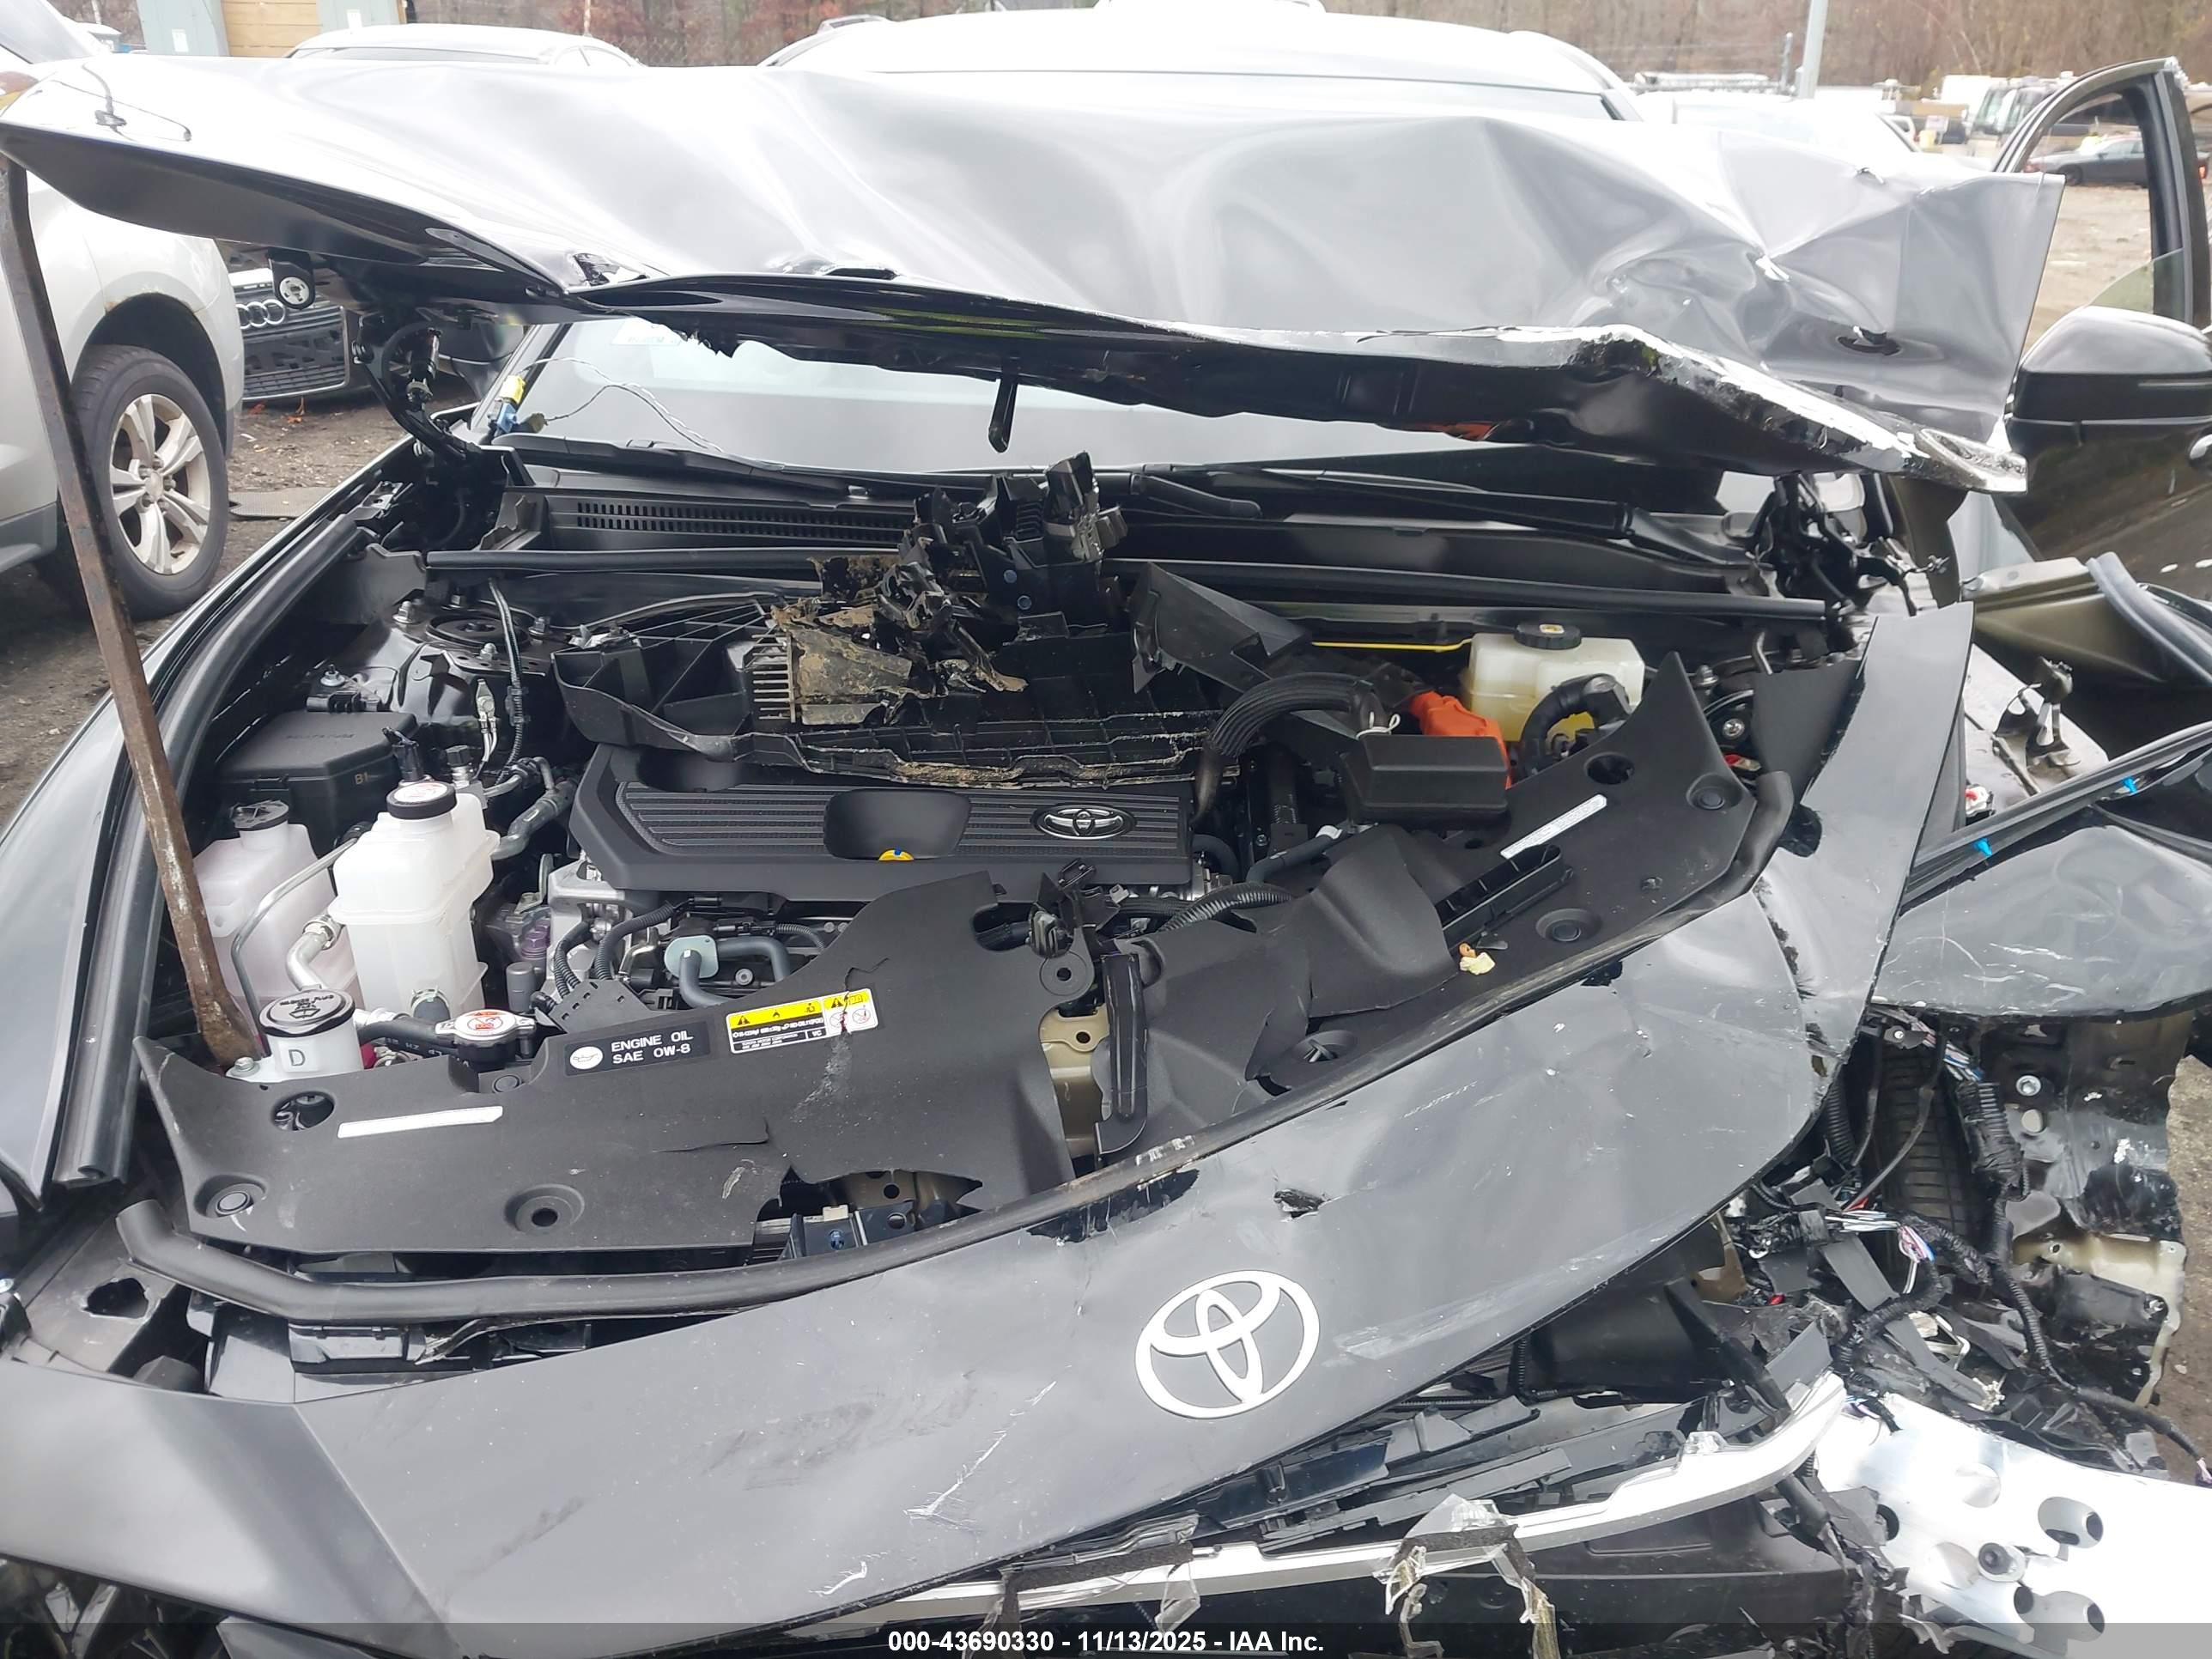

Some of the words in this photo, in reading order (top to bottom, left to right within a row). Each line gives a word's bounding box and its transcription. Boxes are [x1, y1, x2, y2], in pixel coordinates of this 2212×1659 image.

[611, 1035, 663, 1052] ENGINE
[671, 1030, 694, 1042] OIL
[289, 1049, 306, 1066] D
[612, 1050, 644, 1064] SAE
